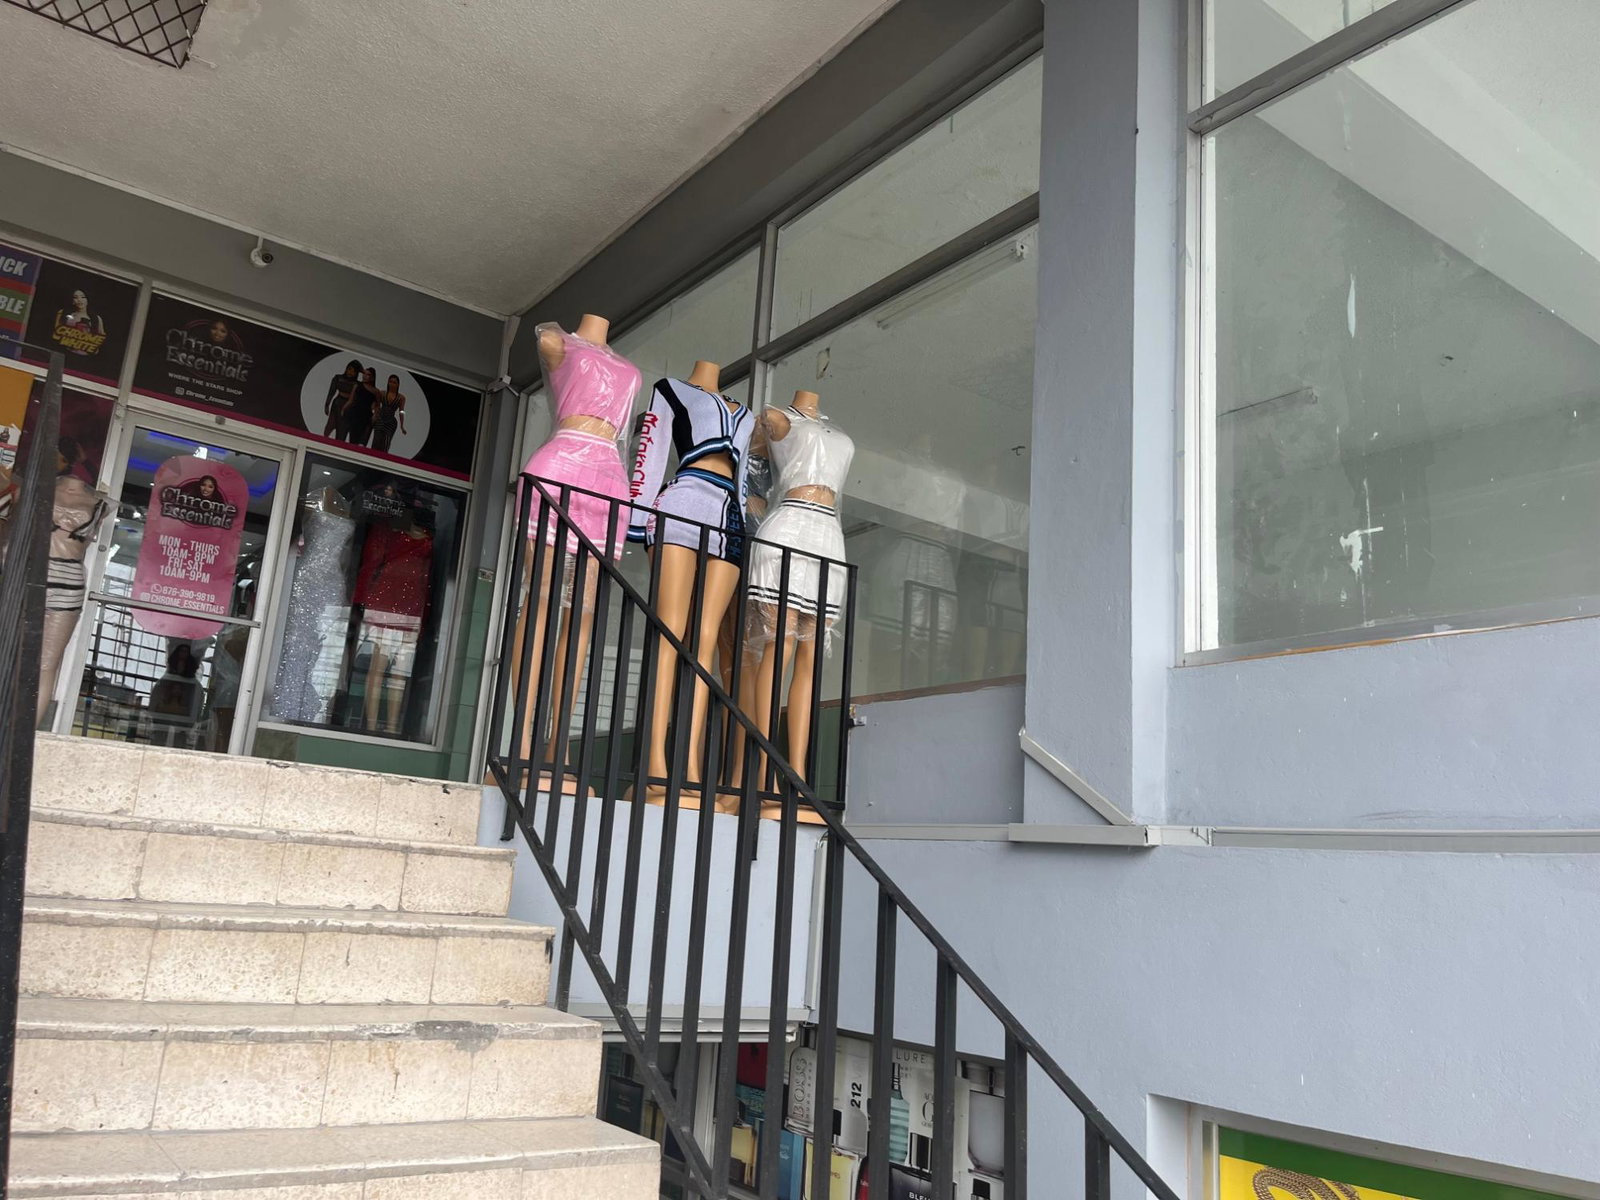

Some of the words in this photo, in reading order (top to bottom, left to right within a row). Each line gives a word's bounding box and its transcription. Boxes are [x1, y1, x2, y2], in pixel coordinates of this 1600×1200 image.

[56, 325, 106, 345] CHROME
[165, 328, 254, 367] Chrome
[165, 345, 249, 382] Essentials
[168, 372, 190, 382] WHERE
[192, 378, 204, 386] THE
[205, 381, 225, 391] STARS
[226, 387, 243, 396] SHOP
[162, 487, 237, 513] Chrome
[162, 502, 232, 529] Essentials
[159, 534, 181, 548] MON
[190, 540, 220, 556] THURS
[167, 556, 205, 572] FRI-SAT
[194, 552, 216, 565] 8PM
[160, 565, 211, 584] 10AM-9PM
[150, 594, 225, 614] CHROME_ESSENTIALS
[896, 1049, 926, 1064] LURE
[850, 1082, 862, 1108] 212
